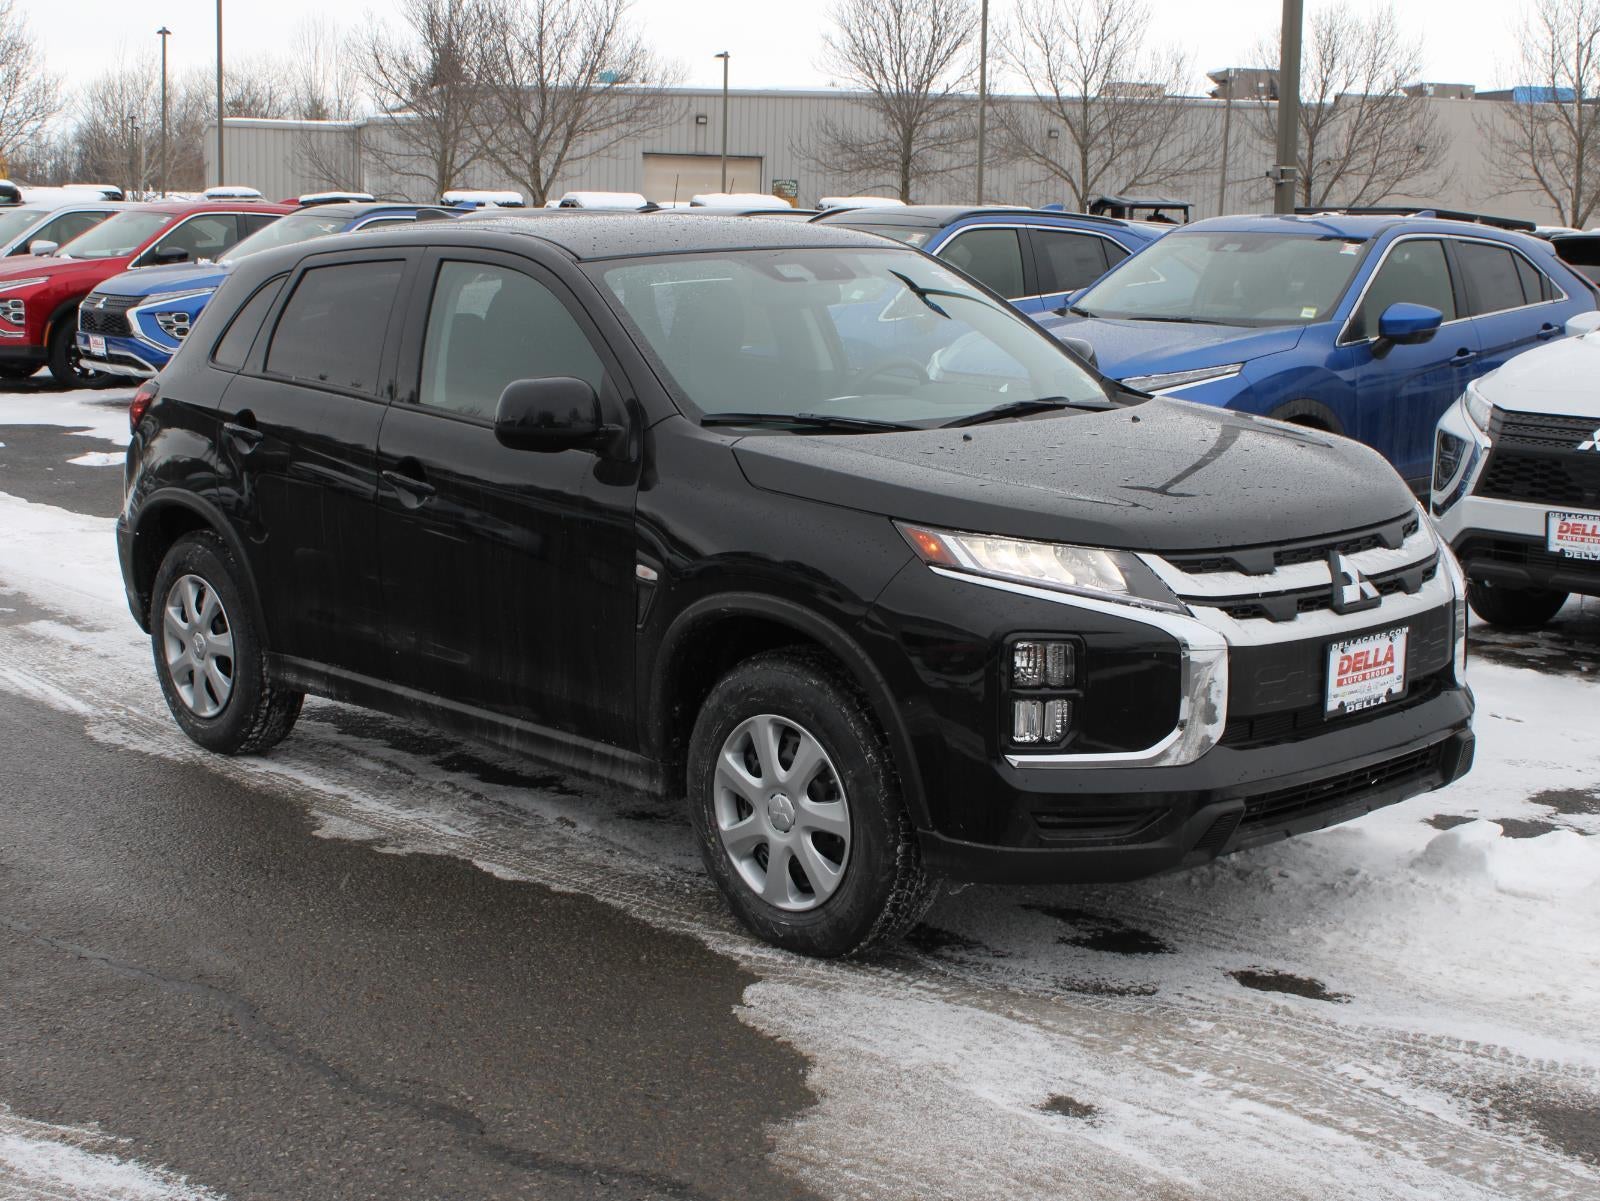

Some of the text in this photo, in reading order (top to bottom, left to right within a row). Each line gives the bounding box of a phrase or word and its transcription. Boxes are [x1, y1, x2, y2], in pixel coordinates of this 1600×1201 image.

[1331, 626, 1409, 651] DELLACARS.COM
[1337, 643, 1395, 676] DELLA
[1342, 667, 1391, 686] AUTO GROUP
[1346, 696, 1387, 713] DELLA
